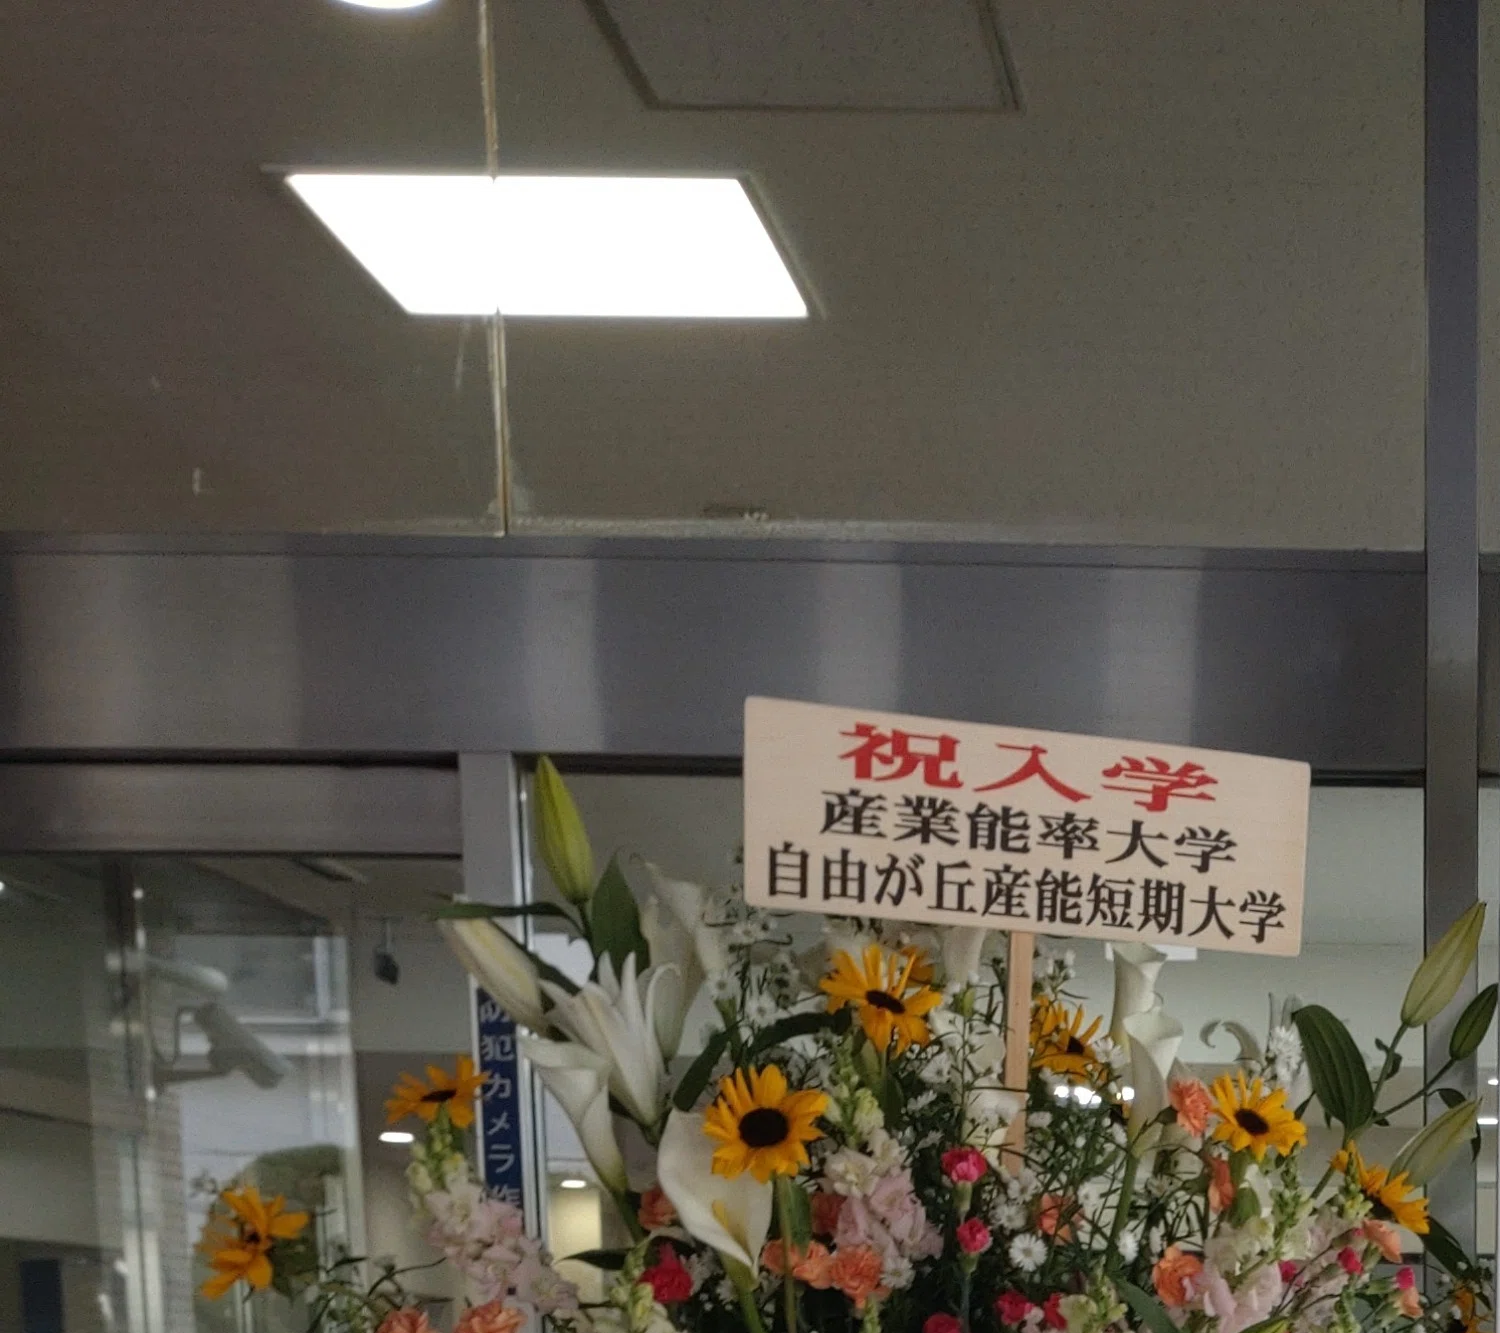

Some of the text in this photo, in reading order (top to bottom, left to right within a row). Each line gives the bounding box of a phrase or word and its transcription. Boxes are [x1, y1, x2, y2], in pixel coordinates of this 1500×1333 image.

[839, 722, 1219, 812] 祝入学
[820, 788, 1239, 873] 産業能率大学
[768, 841, 1286, 944] 自由が丘産能短期大学
